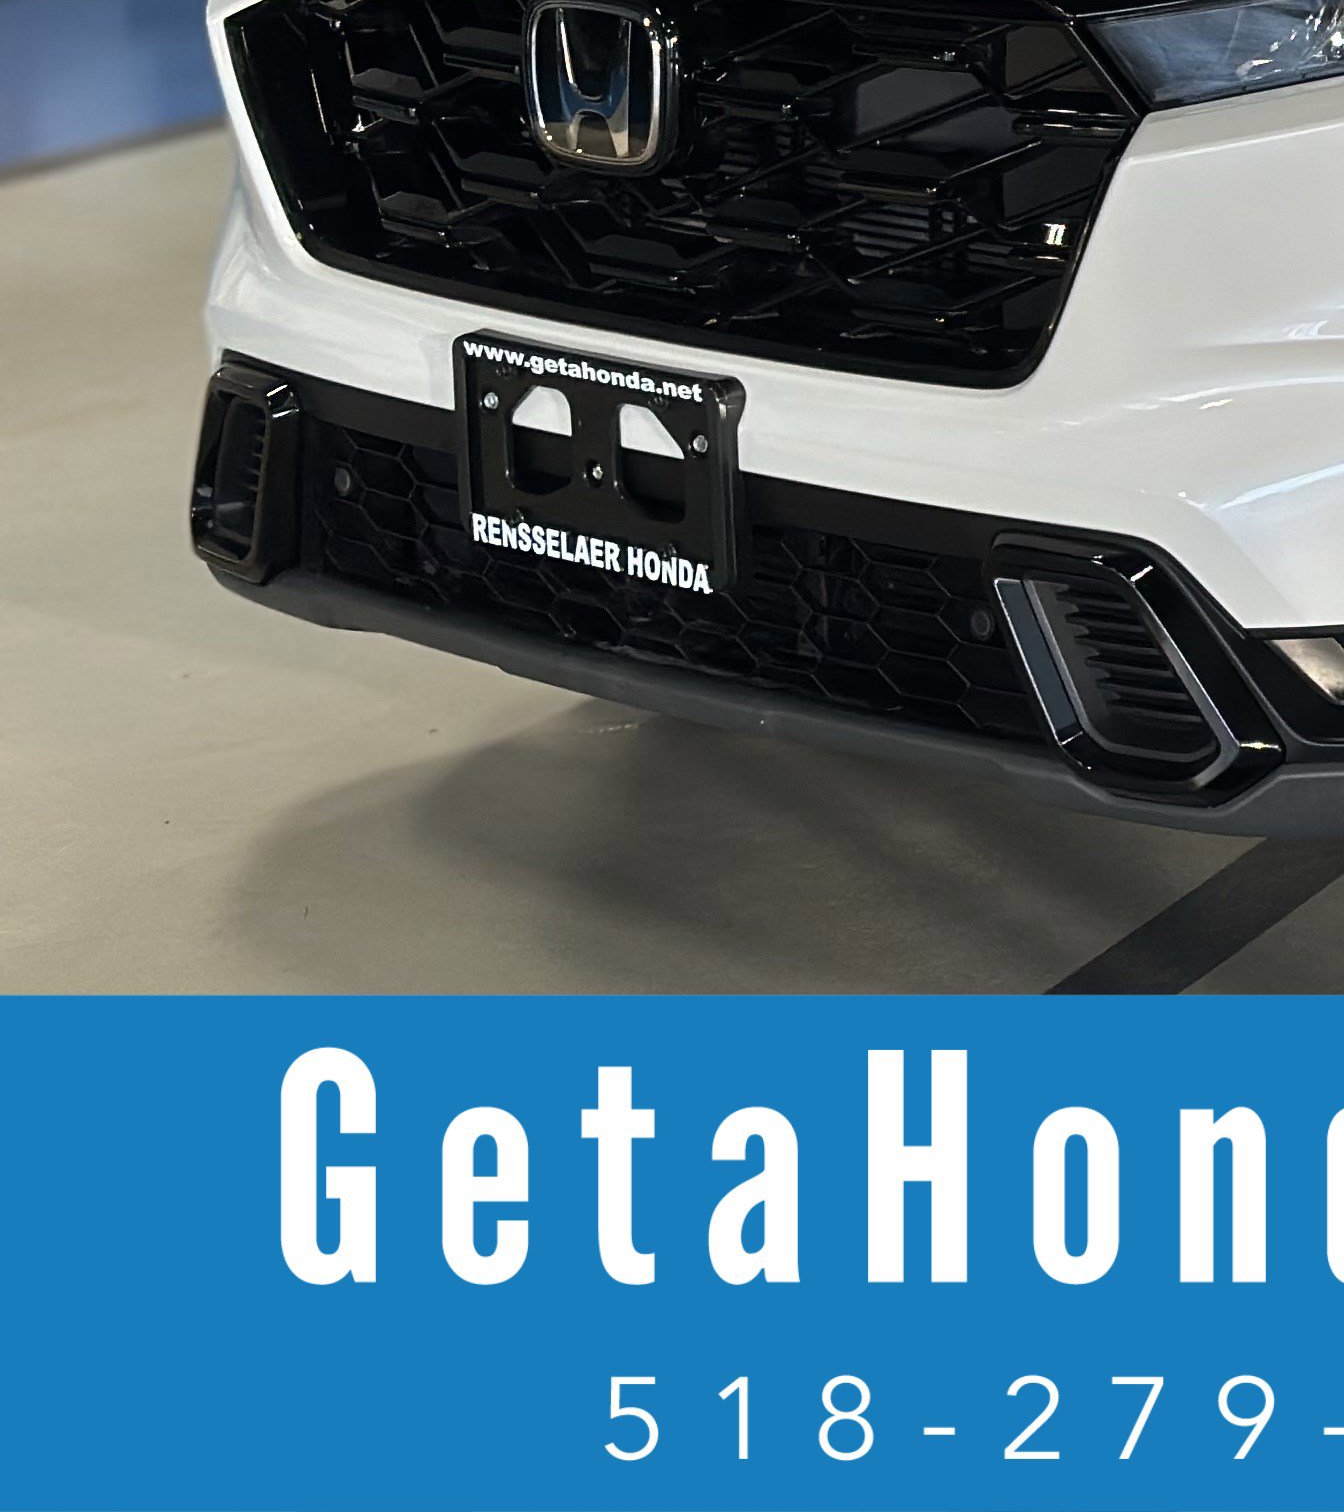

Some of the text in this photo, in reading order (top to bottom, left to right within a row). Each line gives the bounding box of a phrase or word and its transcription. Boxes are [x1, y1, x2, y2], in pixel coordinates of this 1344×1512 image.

[463, 340, 704, 403] www.getahonda.net
[471, 512, 713, 594] RENSSELAER HONDA
